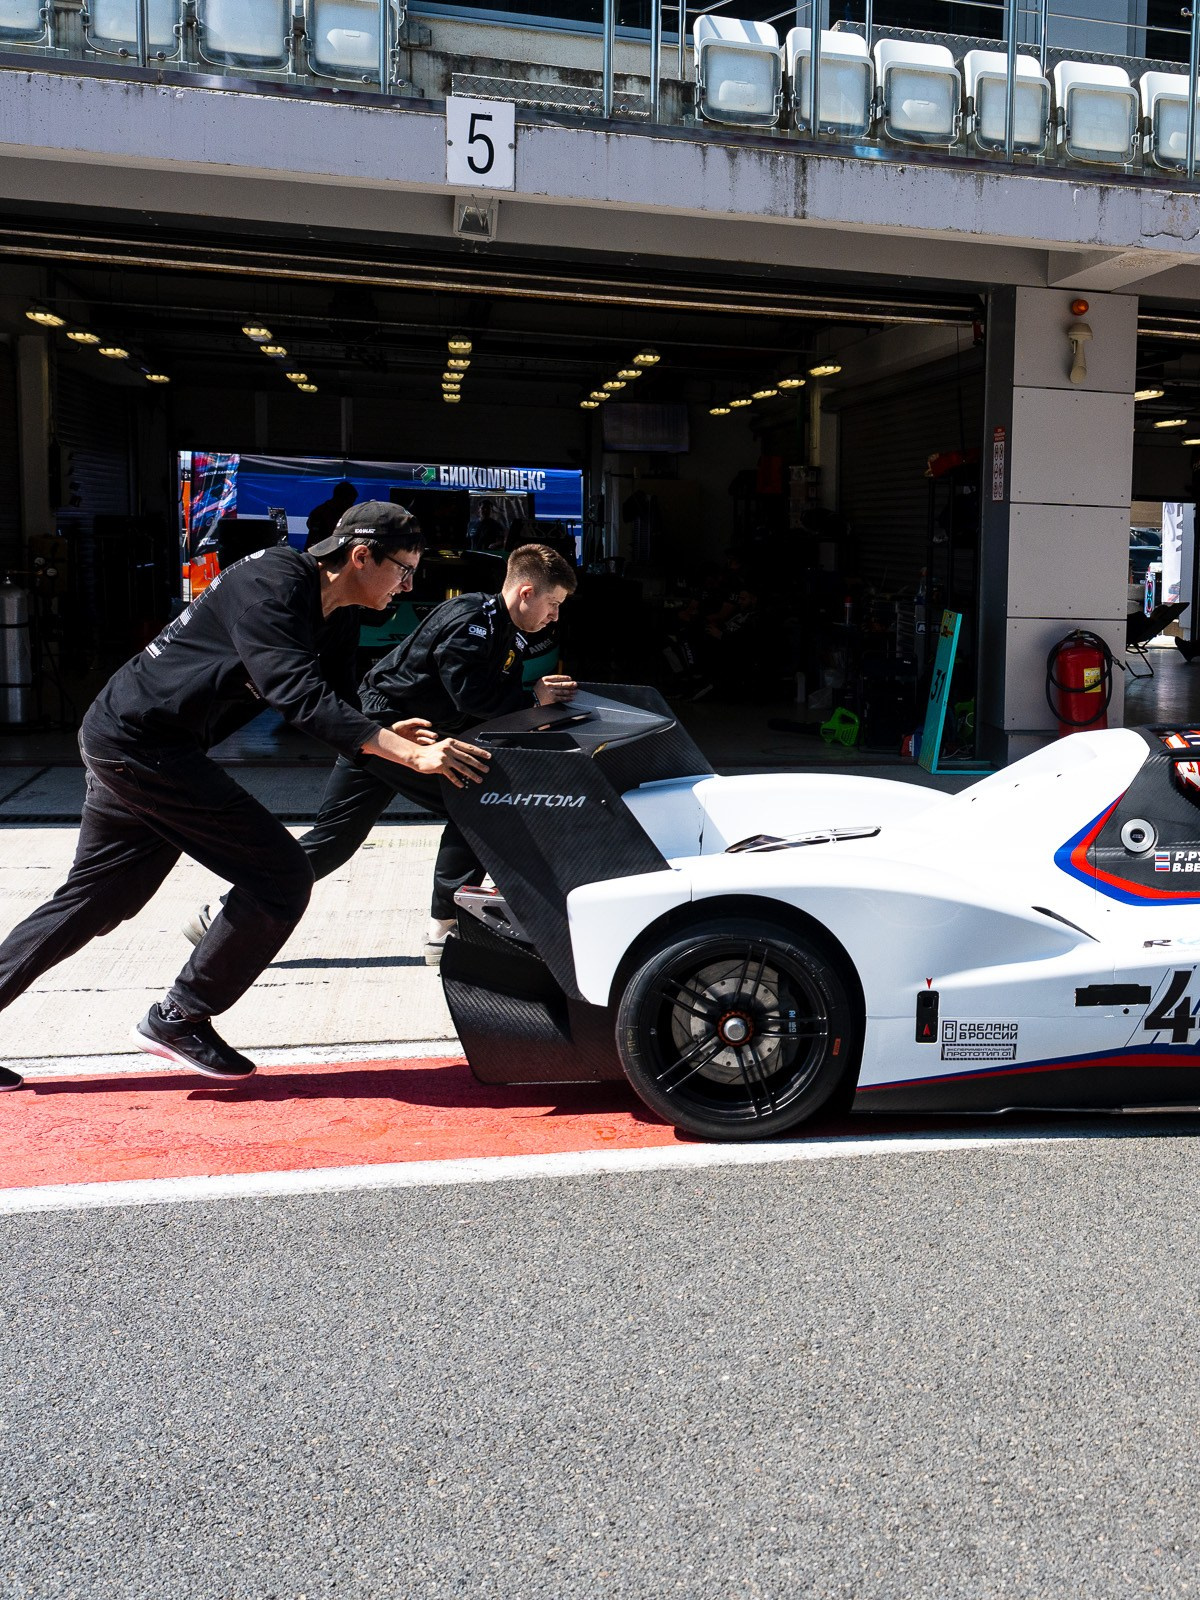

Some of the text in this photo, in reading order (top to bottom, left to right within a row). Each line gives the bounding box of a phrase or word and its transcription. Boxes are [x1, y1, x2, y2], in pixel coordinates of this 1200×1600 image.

[467, 113, 495, 174] 5
[439, 465, 546, 491] БИОКОМПЛЕКС
[468, 625, 487, 637] OMP
[480, 791, 587, 808] ФАНТОМ
[959, 1023, 1019, 1032] СДЕЛАНО
